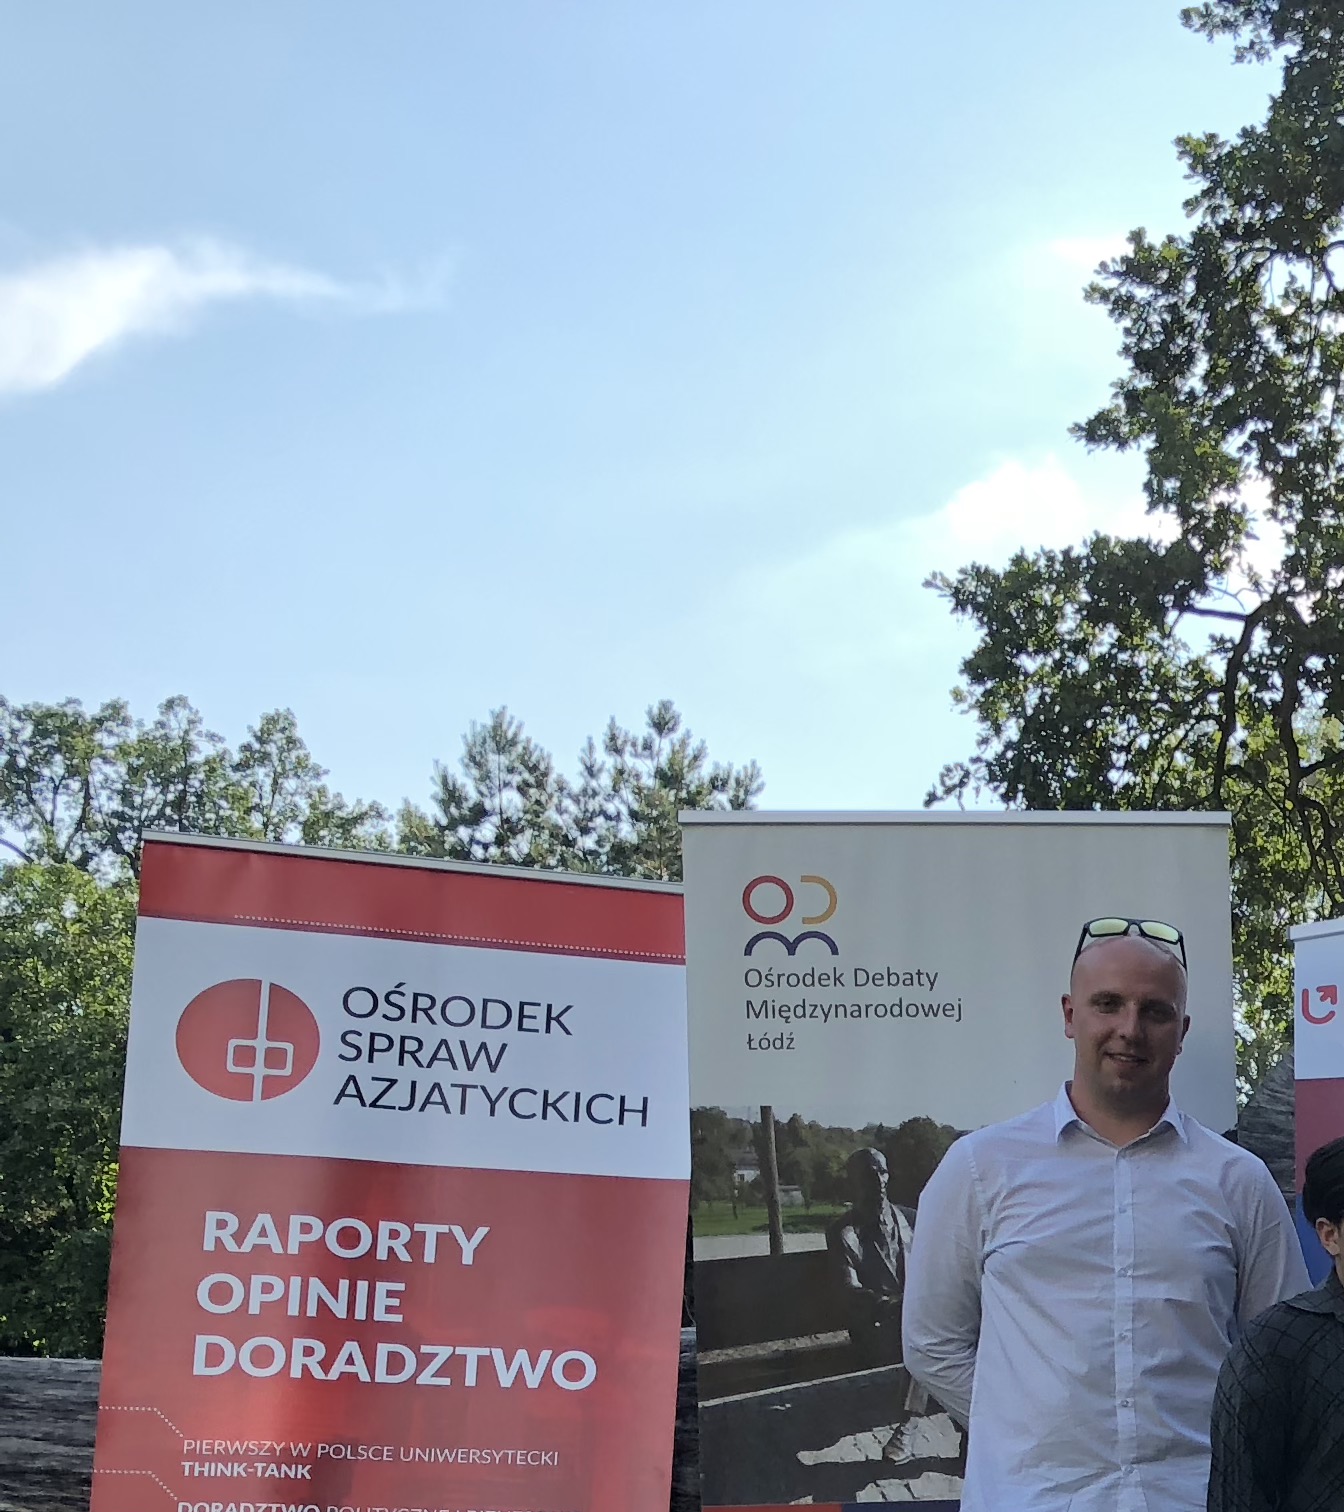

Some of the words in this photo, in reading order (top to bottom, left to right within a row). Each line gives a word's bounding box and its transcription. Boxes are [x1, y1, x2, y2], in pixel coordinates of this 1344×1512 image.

[744, 966, 845, 988] Ośrodek
[854, 966, 939, 991] Debaty
[342, 982, 574, 1036] OŚRODEK
[745, 997, 963, 1024] Międzynarodowej
[337, 1029, 508, 1073] SPRAW
[746, 1032, 795, 1051] Łódź
[333, 1074, 650, 1128] AZJATYCKICH
[202, 1210, 491, 1266] RAPORTY
[196, 1272, 406, 1324] OPINIE
[192, 1333, 597, 1391] DORADZTWO
[181, 1461, 312, 1480] THINK-TANK
[183, 1439, 285, 1457] PIERWSZY
[290, 1442, 312, 1458] W
[317, 1443, 394, 1461] POLSCE
[399, 1446, 560, 1466] UNIWERSYTECKI
